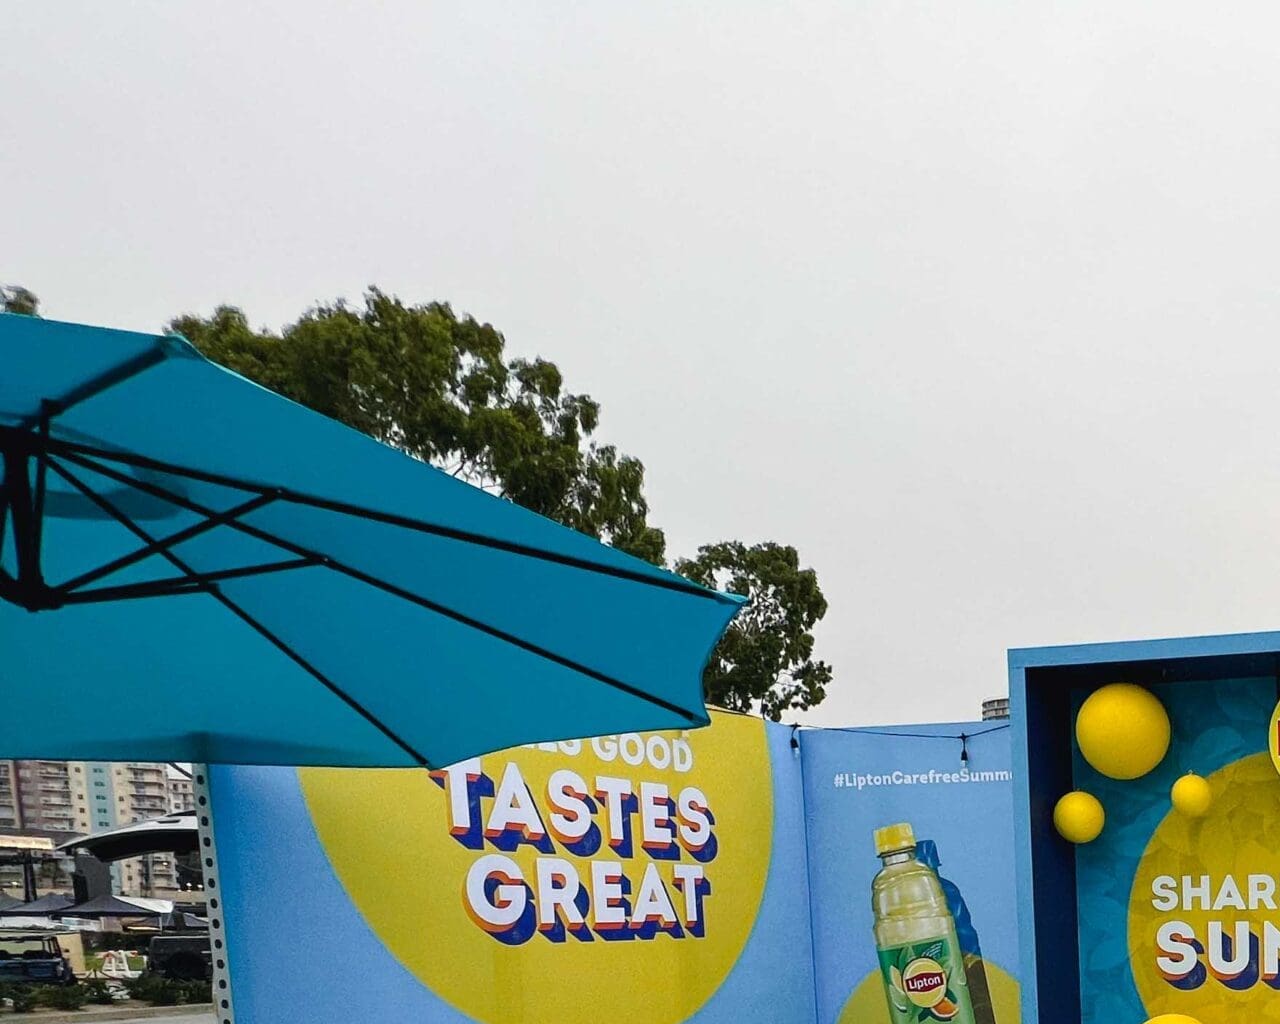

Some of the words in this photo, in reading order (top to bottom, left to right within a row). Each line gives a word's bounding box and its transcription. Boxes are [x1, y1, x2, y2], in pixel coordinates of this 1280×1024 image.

[592, 733, 693, 773] GOOD
[833, 768, 1012, 790] #LiptonCarefreeSumm
[430, 757, 718, 863] TASTES
[462, 854, 711, 945] GREAT
[908, 975, 941, 991] Lipton
